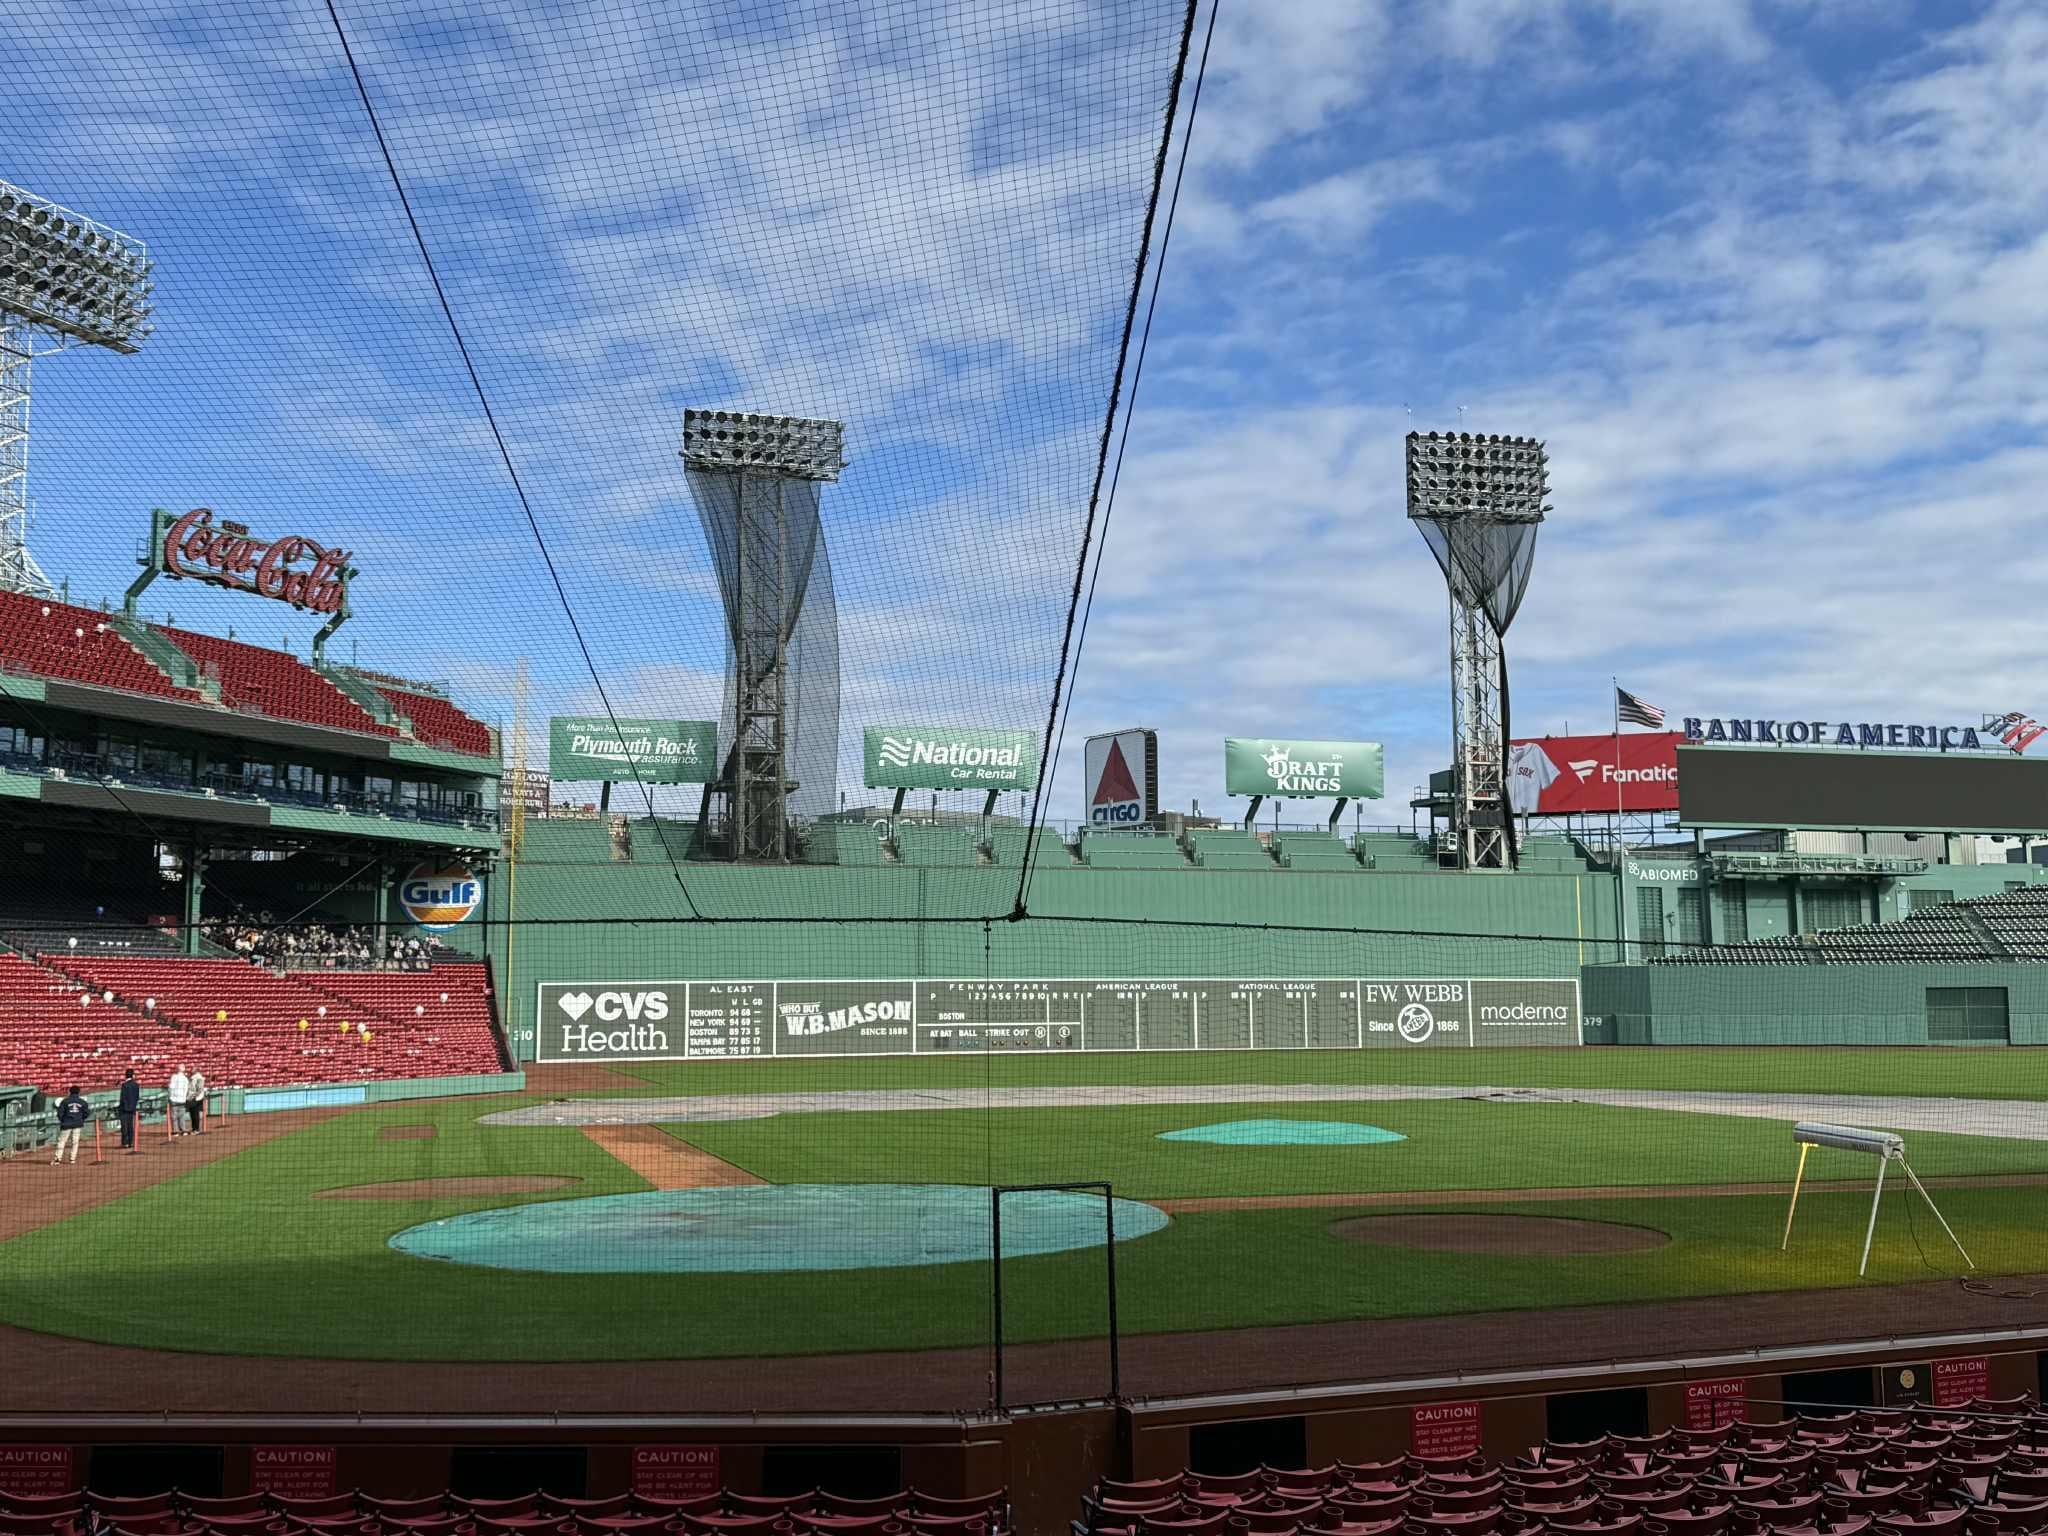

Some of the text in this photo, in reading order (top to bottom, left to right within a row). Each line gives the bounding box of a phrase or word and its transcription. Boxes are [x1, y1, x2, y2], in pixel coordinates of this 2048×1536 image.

[164, 508, 352, 613] Coca-Cola
[1683, 717, 1982, 749] BANK OF AMERICA
[571, 735, 698, 756] Plymouth Rock
[641, 755, 698, 764] assurance
[912, 741, 1021, 766] National
[502, 770, 549, 782] IGLOW
[951, 767, 1016, 780] Car Rental
[1267, 760, 1343, 780] DRAFT
[1517, 766, 1535, 779] SOX
[1276, 775, 1341, 791] KINGS
[1093, 803, 1140, 825] CITGO
[1640, 869, 1698, 880] ABIOMED
[403, 882, 475, 904] Gulf
[727, 985, 754, 993] EAST
[1014, 983, 1049, 991] PARK
[1404, 984, 1463, 1002] WEBB
[595, 991, 668, 1021] CVS
[779, 1003, 820, 1014] WHO BUT
[1480, 1002, 1568, 1020] moderna
[1369, 1021, 1459, 1031] Since 1866
[1583, 1017, 1602, 1026] 379
[561, 1023, 669, 1052] Health
[689, 1028, 718, 1036] BOSTON
[754, 1027, 760, 1035] 5
[860, 1027, 887, 1036] SINCE
[959, 1029, 977, 1037] BALL
[985, 1029, 1010, 1037] STRIKE
[1013, 1029, 1030, 1037] OUT
[689, 1047, 727, 1055] BALTIMORE
[1937, 1360, 1986, 1374] CAUTION!
[1689, 1384, 1743, 1397] CAUTION!
[1416, 1406, 1477, 1421] CAUTION!
[256, 1451, 331, 1462] CAUTION!
[637, 1452, 714, 1463] CAUTION!
